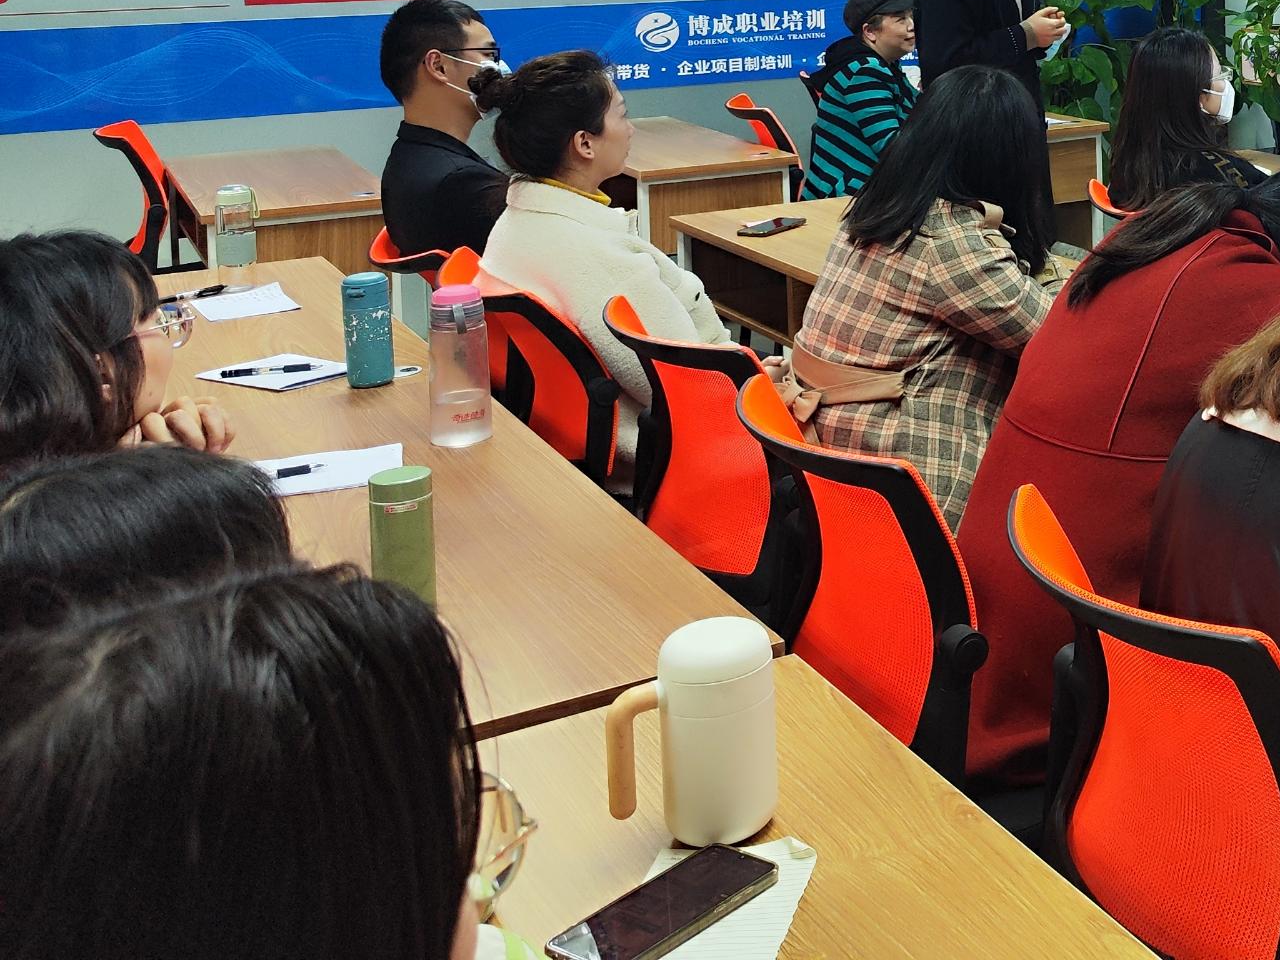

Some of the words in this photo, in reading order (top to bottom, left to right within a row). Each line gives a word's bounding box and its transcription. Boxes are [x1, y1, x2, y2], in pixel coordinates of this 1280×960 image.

[687, 9, 826, 37] 博成职业培训
[687, 38, 729, 46] BOCHENG
[732, 35, 785, 43] VOCATIONAL
[787, 32, 826, 40] TRAINING
[677, 54, 792, 76] 企业项目制培训
